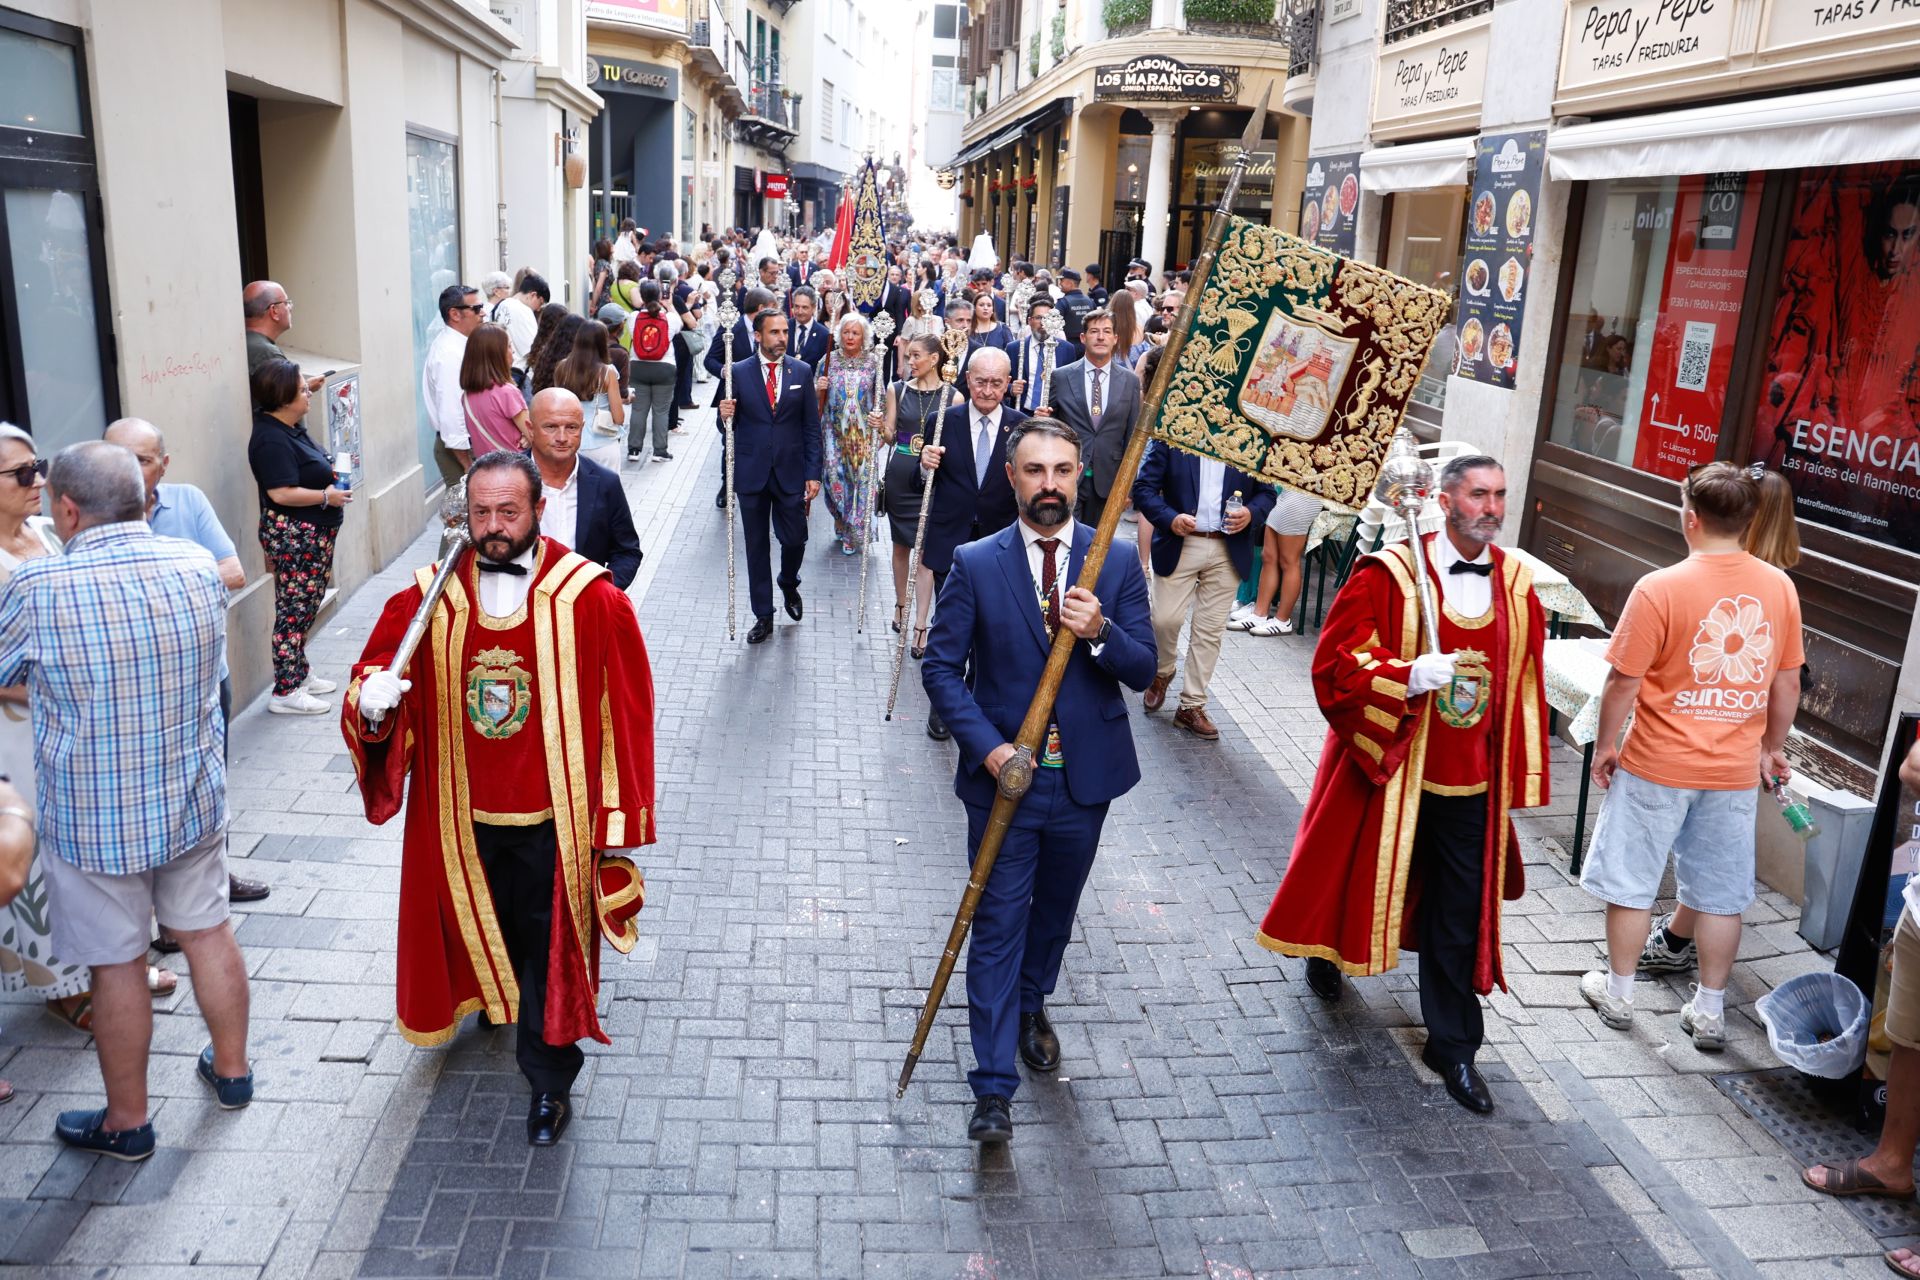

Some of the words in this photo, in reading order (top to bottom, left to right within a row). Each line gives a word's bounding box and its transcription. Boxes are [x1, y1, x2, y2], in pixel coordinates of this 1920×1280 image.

[1814, 0, 1864, 26] TAPAS
[1580, 6, 1633, 50] Pepa
[1626, 16, 1650, 63] y
[1592, 53, 1623, 71] TAPAS
[1638, 35, 1699, 62] FREIDURIA
[603, 64, 620, 81] TU
[1127, 59, 1177, 73] CASONA
[1394, 59, 1423, 92] Pepa
[1419, 70, 1433, 103] y
[1435, 47, 1468, 83] Pepe
[1097, 74, 1121, 87] LOS
[1125, 71, 1221, 87] MARANGÓS
[1146, 84, 1183, 92] ESPAÑOLA
[1400, 95, 1418, 107] TAPAS
[1425, 87, 1459, 104] FREIDURIA
[1709, 192, 1736, 213] CO
[1792, 419, 1920, 477] ESENCIA
[1782, 454, 1801, 470] Las
[1804, 461, 1838, 479] raíces
[1840, 468, 1861, 485] del
[1863, 472, 1920, 500] flamenco
[1796, 495, 1889, 528] teatroflamencomalaga.com
[1695, 708, 1742, 718] SUNFLOWER
